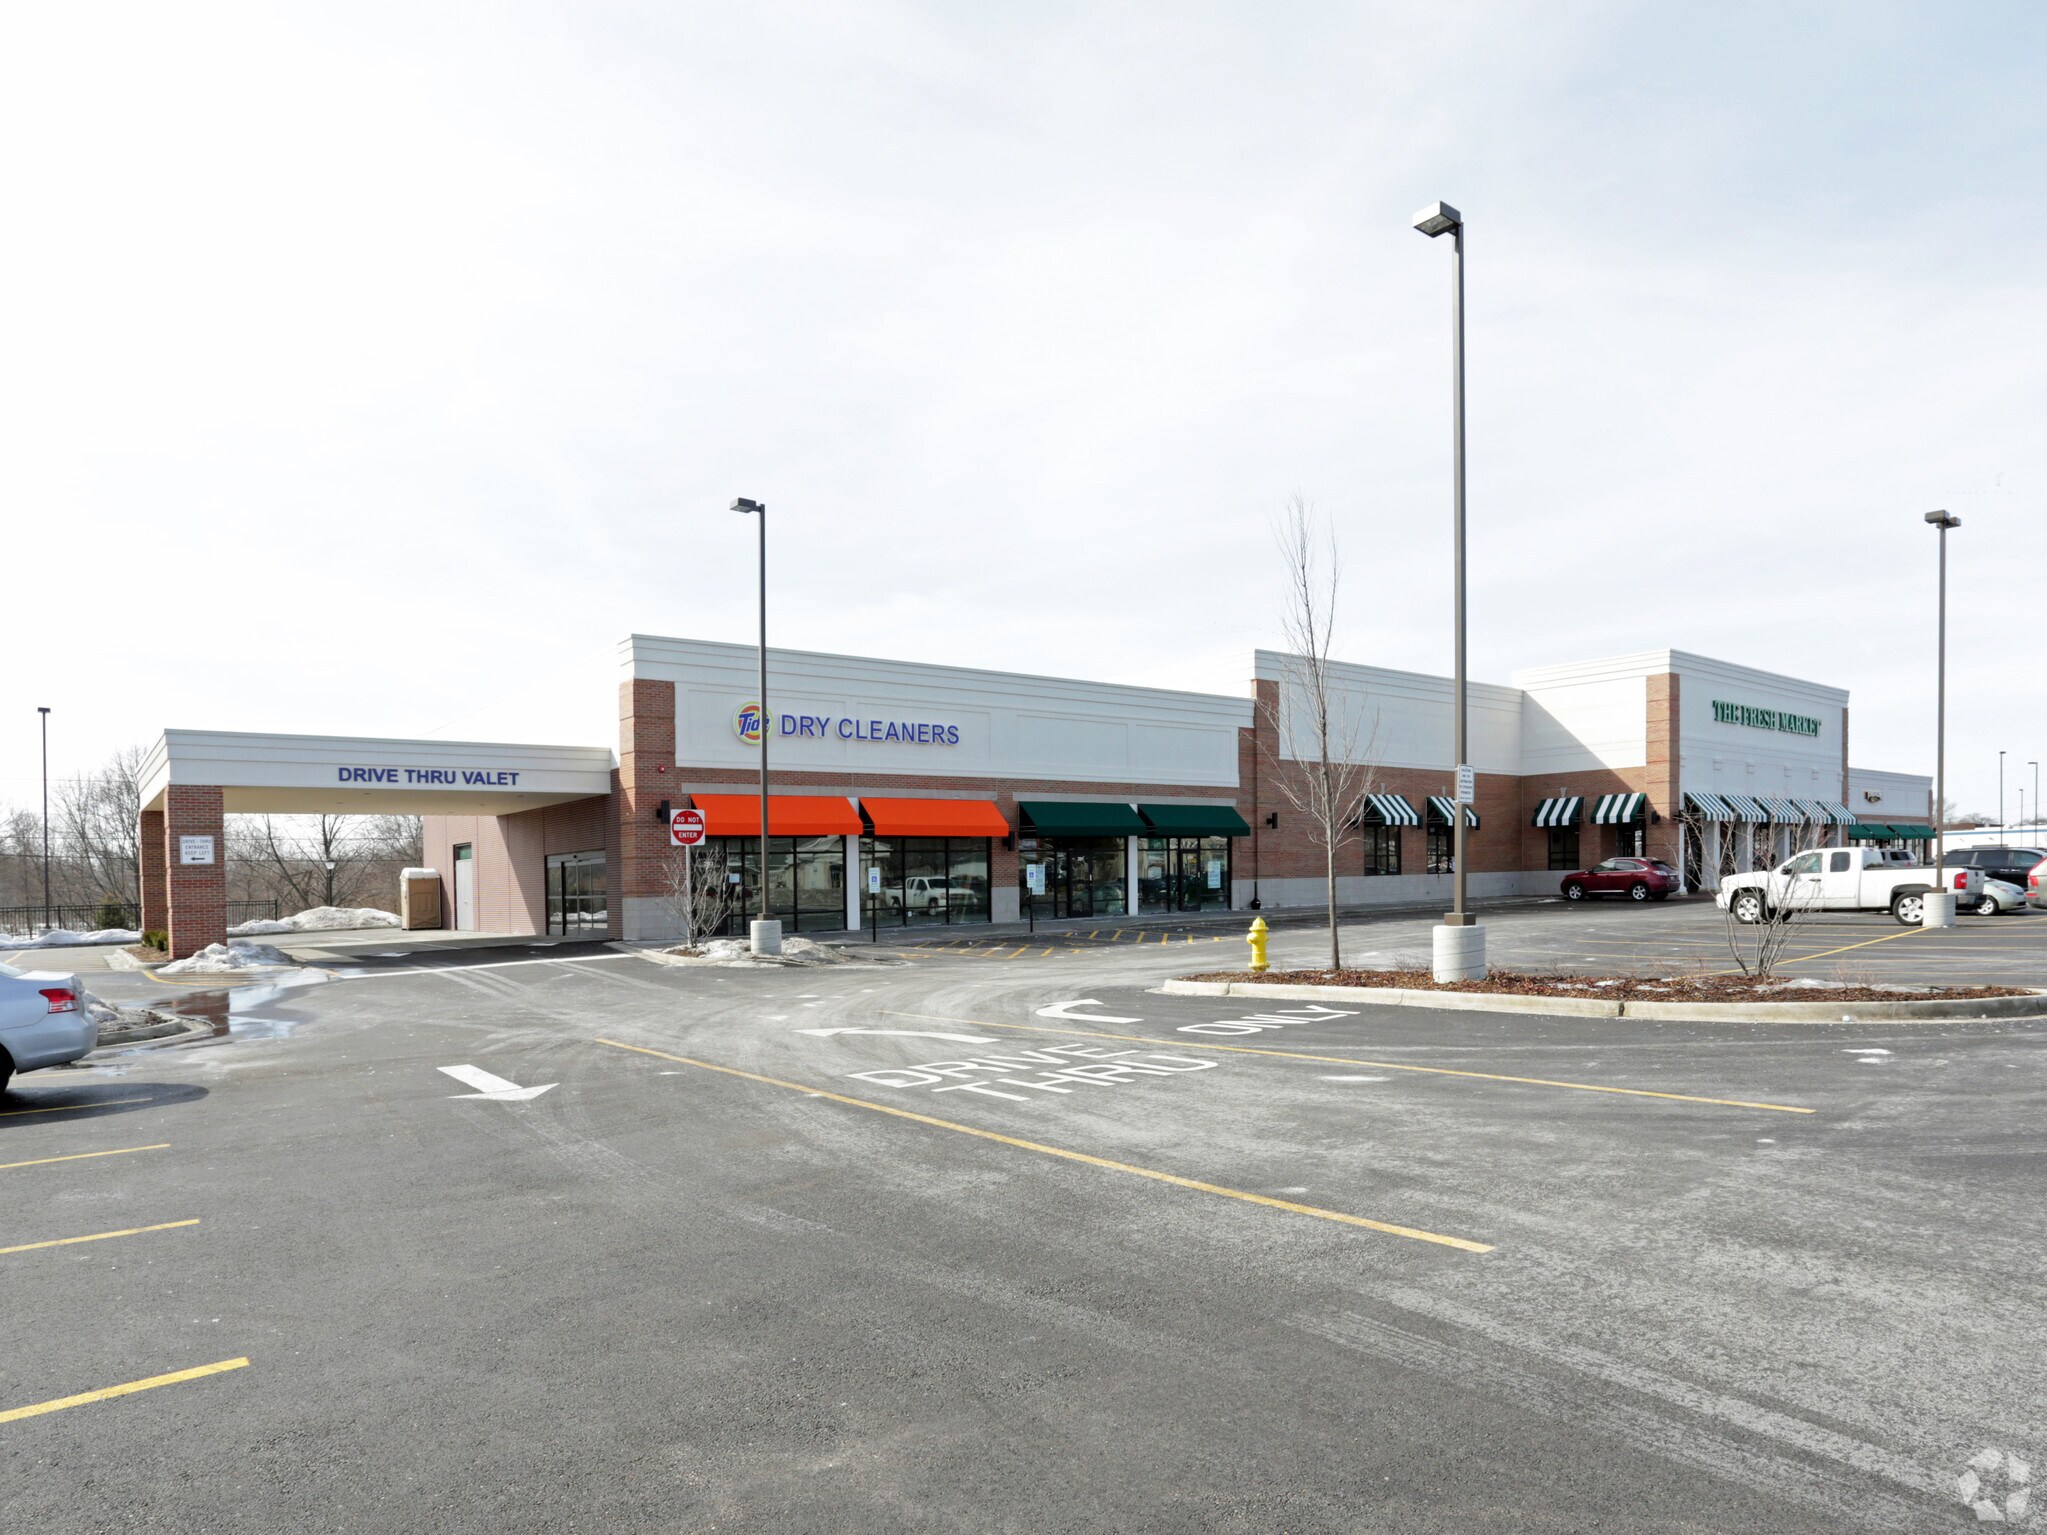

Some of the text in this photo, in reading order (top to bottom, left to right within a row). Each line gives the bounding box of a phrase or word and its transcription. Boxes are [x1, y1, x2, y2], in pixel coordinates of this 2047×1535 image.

[781, 714, 830, 737] DRY
[838, 718, 960, 745] CLEANERS
[1712, 699, 1821, 737] THE FRESH MARKET
[338, 767, 520, 786] DRIVE THRU VALET
[1176, 1005, 1361, 1035] ONLY
[845, 1043, 1140, 1088] DRIVE
[931, 1055, 1219, 1101] THRU
